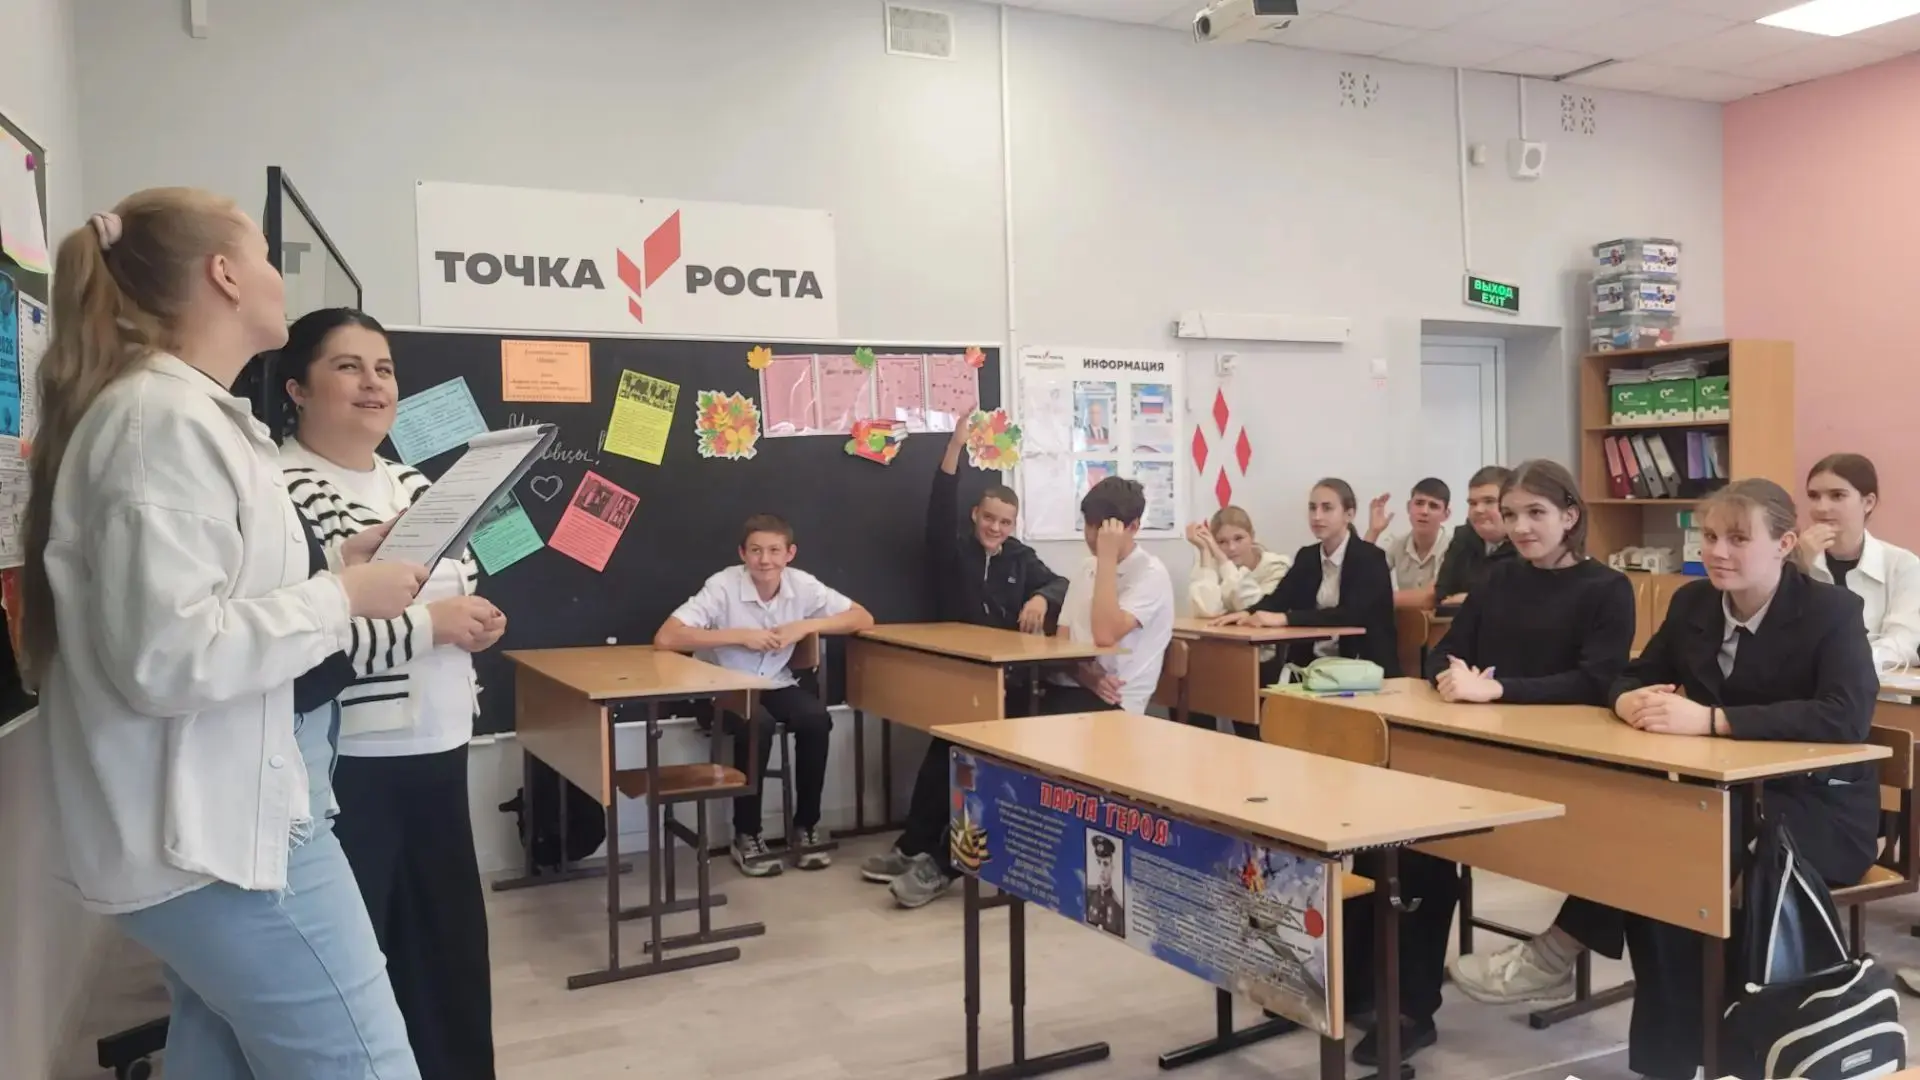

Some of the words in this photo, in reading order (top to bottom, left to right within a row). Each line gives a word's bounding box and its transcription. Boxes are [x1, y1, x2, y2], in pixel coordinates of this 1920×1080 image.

[434, 250, 605, 291] ТОЧКА
[685, 264, 824, 300] РОСТА
[1474, 279, 1514, 299] ВЫХОД
[1481, 292, 1506, 307] EXIT
[1083, 357, 1165, 373] ИНФОРМАЦИЯ
[1040, 782, 1098, 822] ПАРТА
[1105, 803, 1170, 846] ГЕРОЯ
